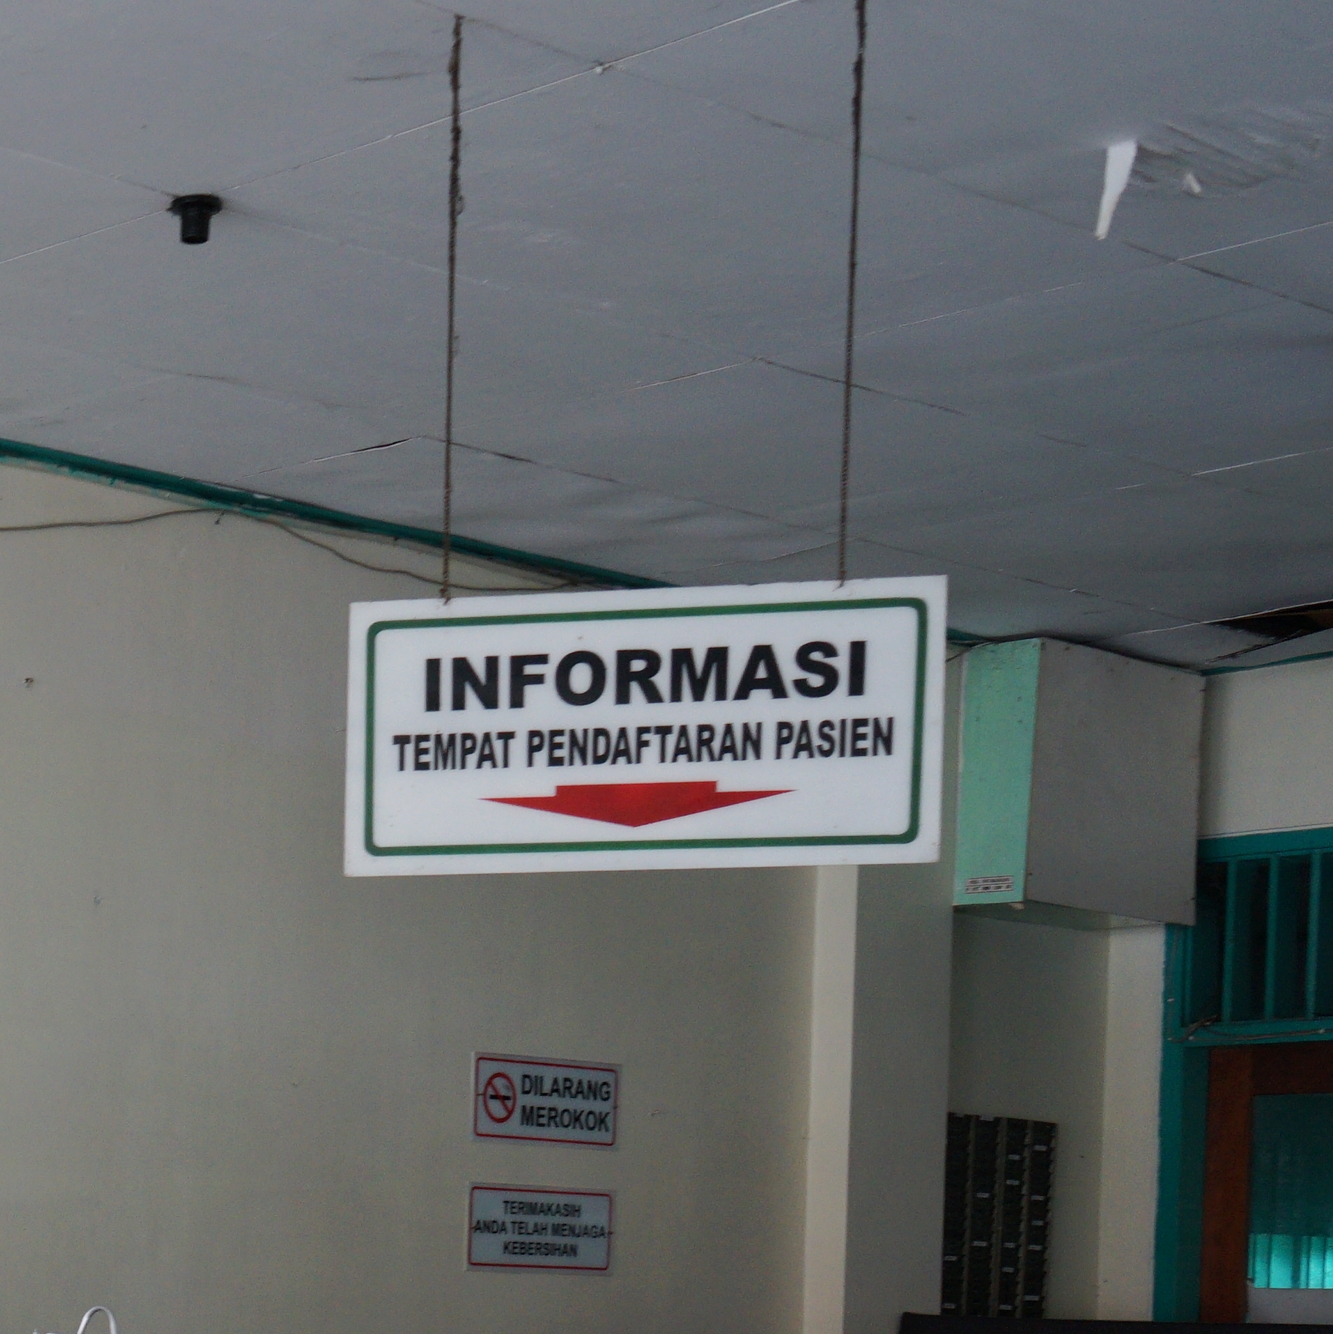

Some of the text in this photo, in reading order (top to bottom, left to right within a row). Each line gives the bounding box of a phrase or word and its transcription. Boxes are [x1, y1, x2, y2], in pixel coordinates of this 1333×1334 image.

[424, 640, 868, 713] INFORMASI
[392, 716, 895, 772] TEMPAT PENDAFTARAN PASIEN
[521, 1074, 612, 1102] DILARANG
[520, 1105, 611, 1132] MEROKOK
[473, 1219, 607, 1239] ANDA TELAH MENJAGA
